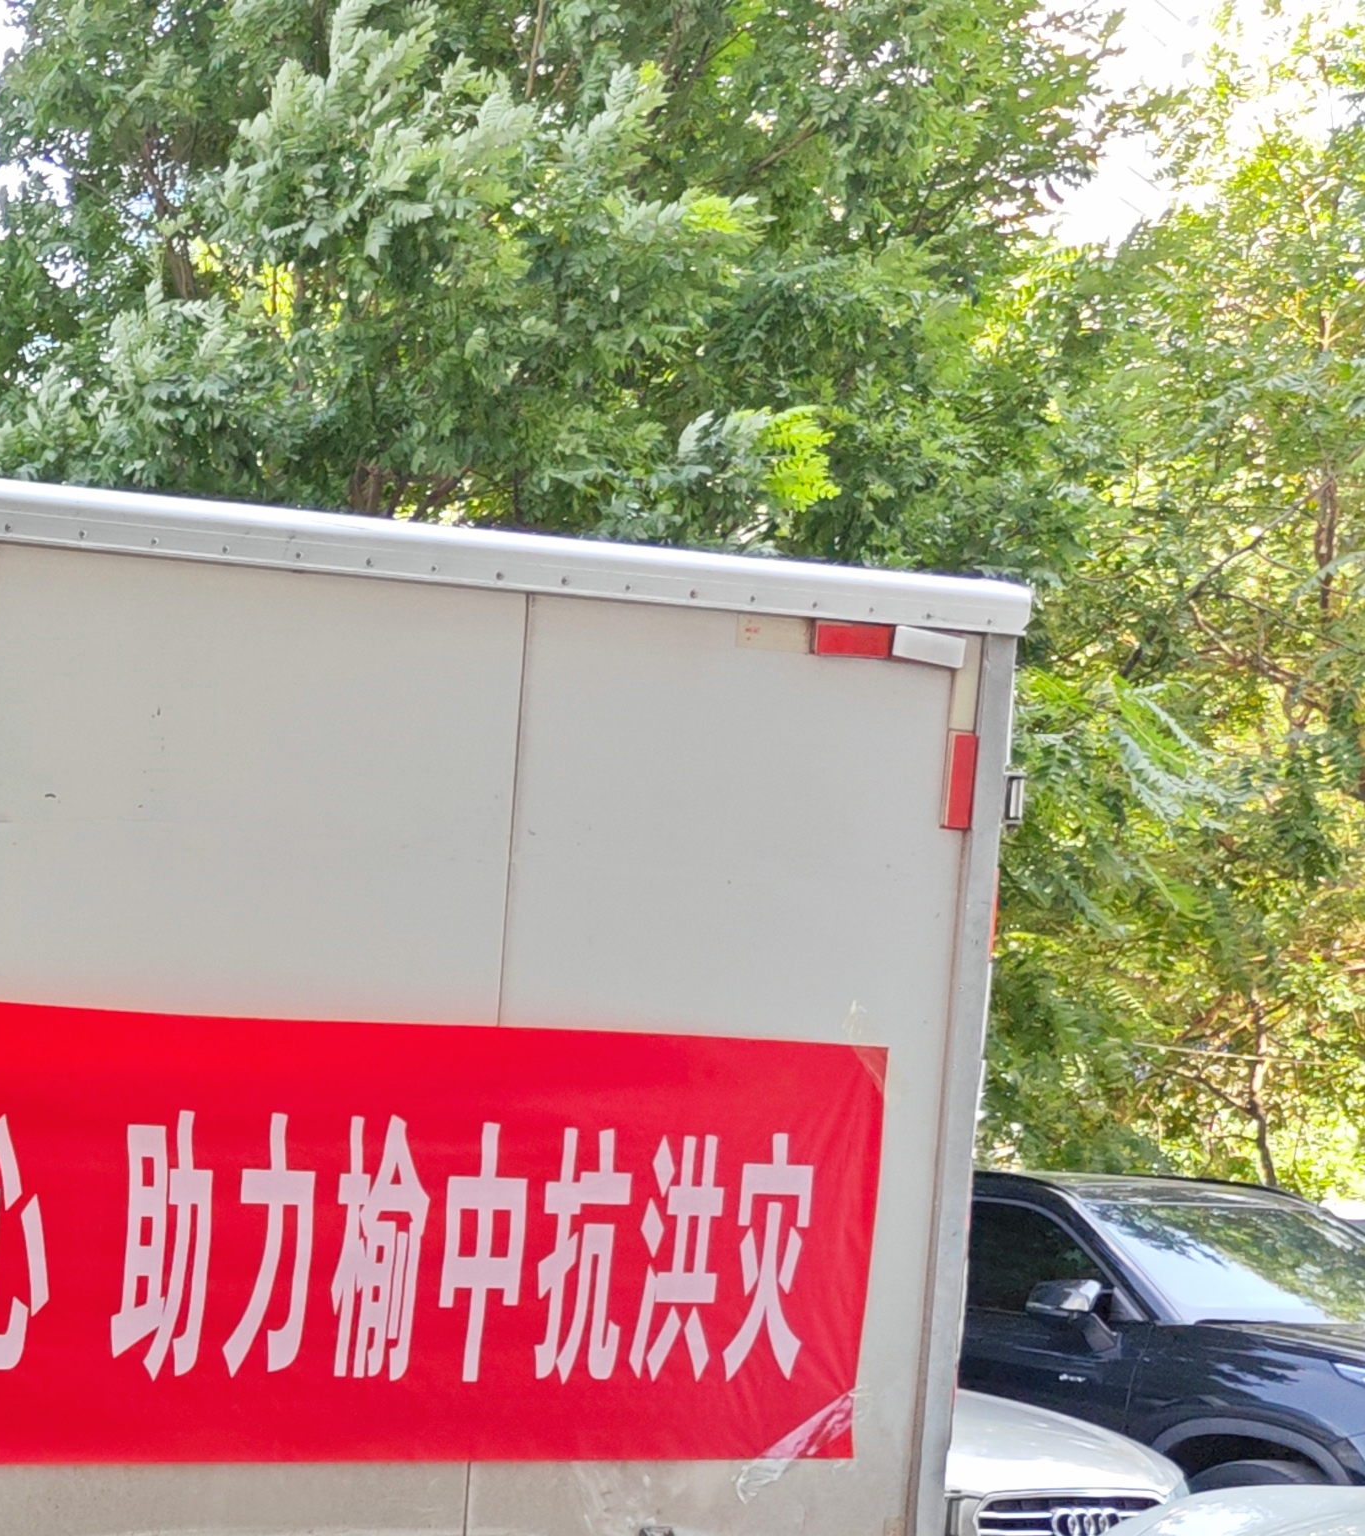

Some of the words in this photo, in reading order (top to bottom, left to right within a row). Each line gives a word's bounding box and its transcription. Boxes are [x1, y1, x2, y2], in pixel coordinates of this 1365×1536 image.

[111, 1110, 814, 1383] 助力榆中抗洪灾
